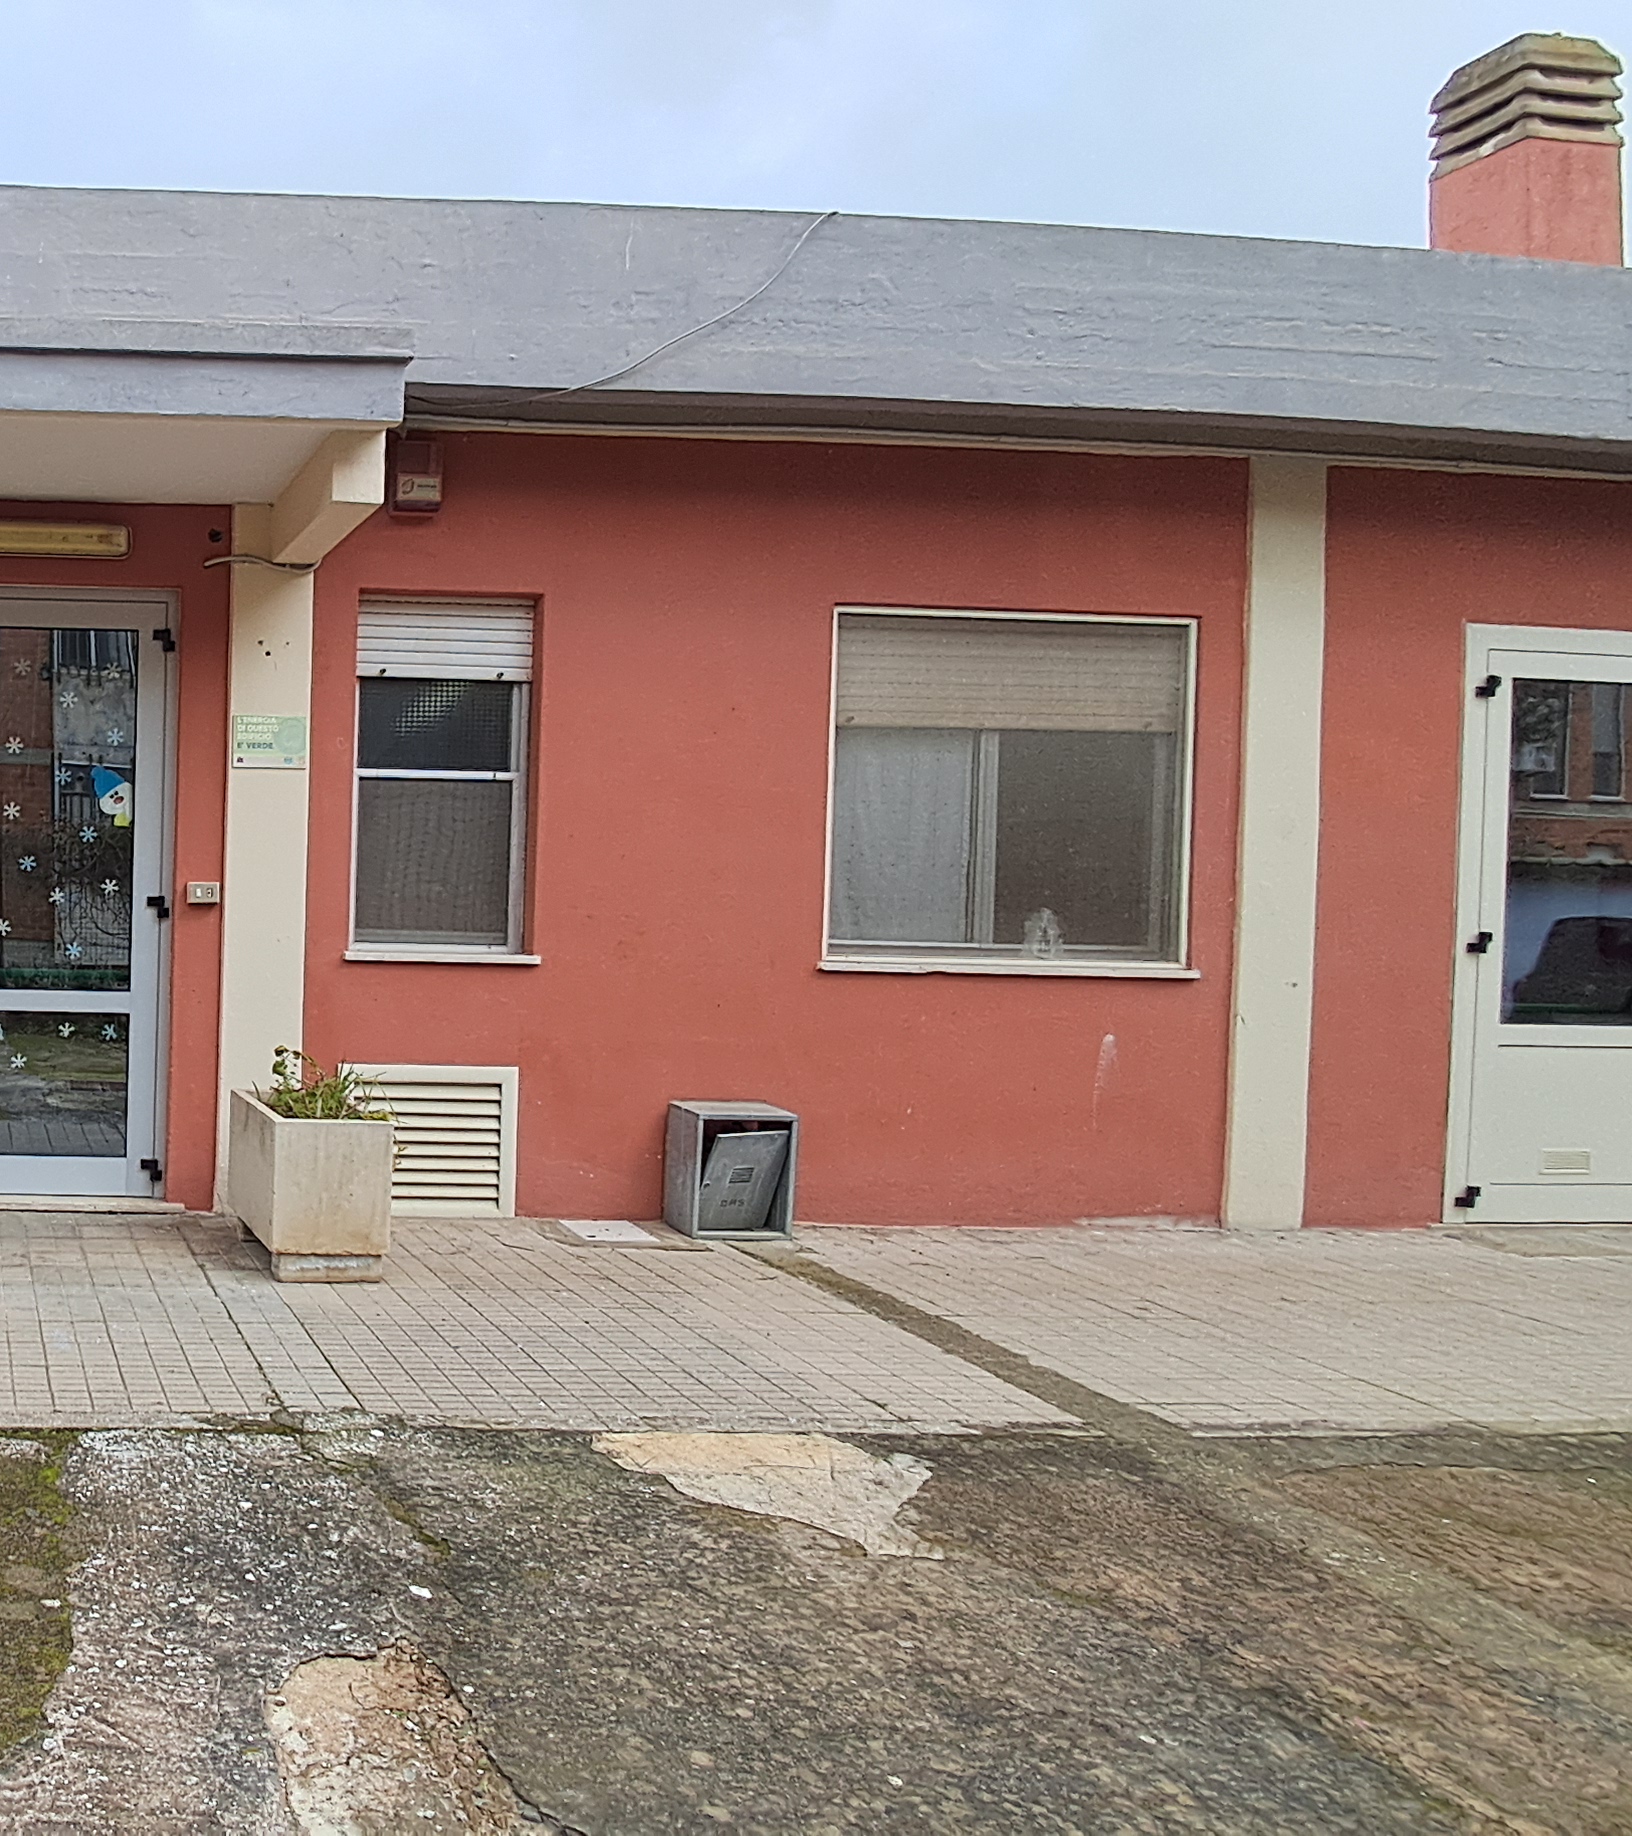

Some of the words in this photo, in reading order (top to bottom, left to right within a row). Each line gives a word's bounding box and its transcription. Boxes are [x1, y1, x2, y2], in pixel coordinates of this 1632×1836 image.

[247, 724, 280, 732] QUESTO
[246, 742, 274, 750] VERDE
[719, 1198, 745, 1207] GAS
